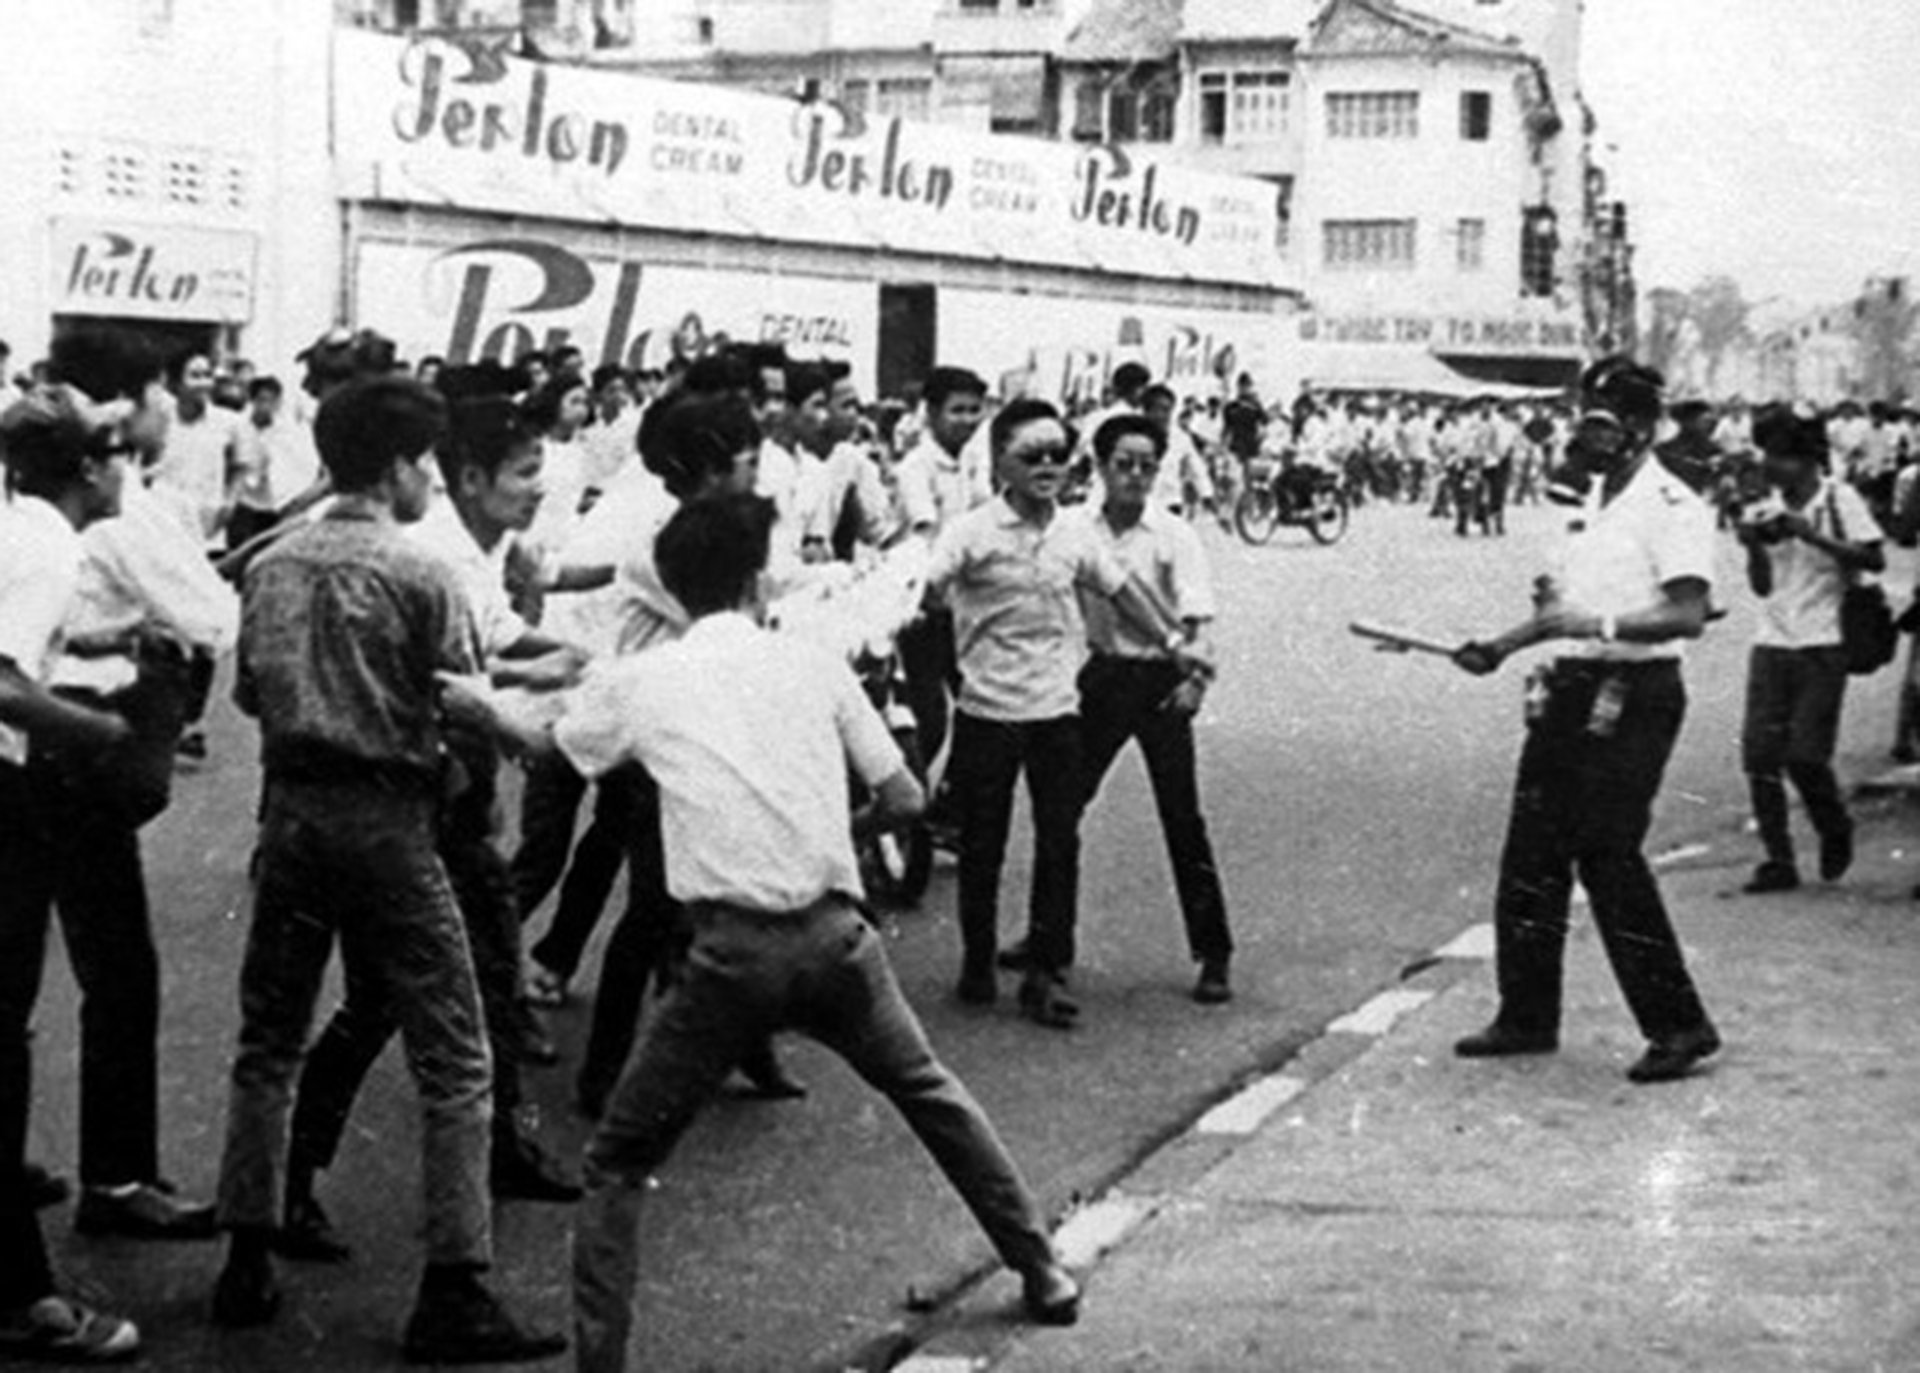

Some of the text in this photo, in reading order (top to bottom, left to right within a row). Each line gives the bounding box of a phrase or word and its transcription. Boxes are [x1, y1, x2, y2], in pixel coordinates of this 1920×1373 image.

[393, 36, 628, 176] Perlon
[652, 108, 744, 144] DENTAL
[787, 98, 954, 211] Perlon
[650, 144, 744, 175] CREAM
[1071, 142, 1200, 246] Perlon
